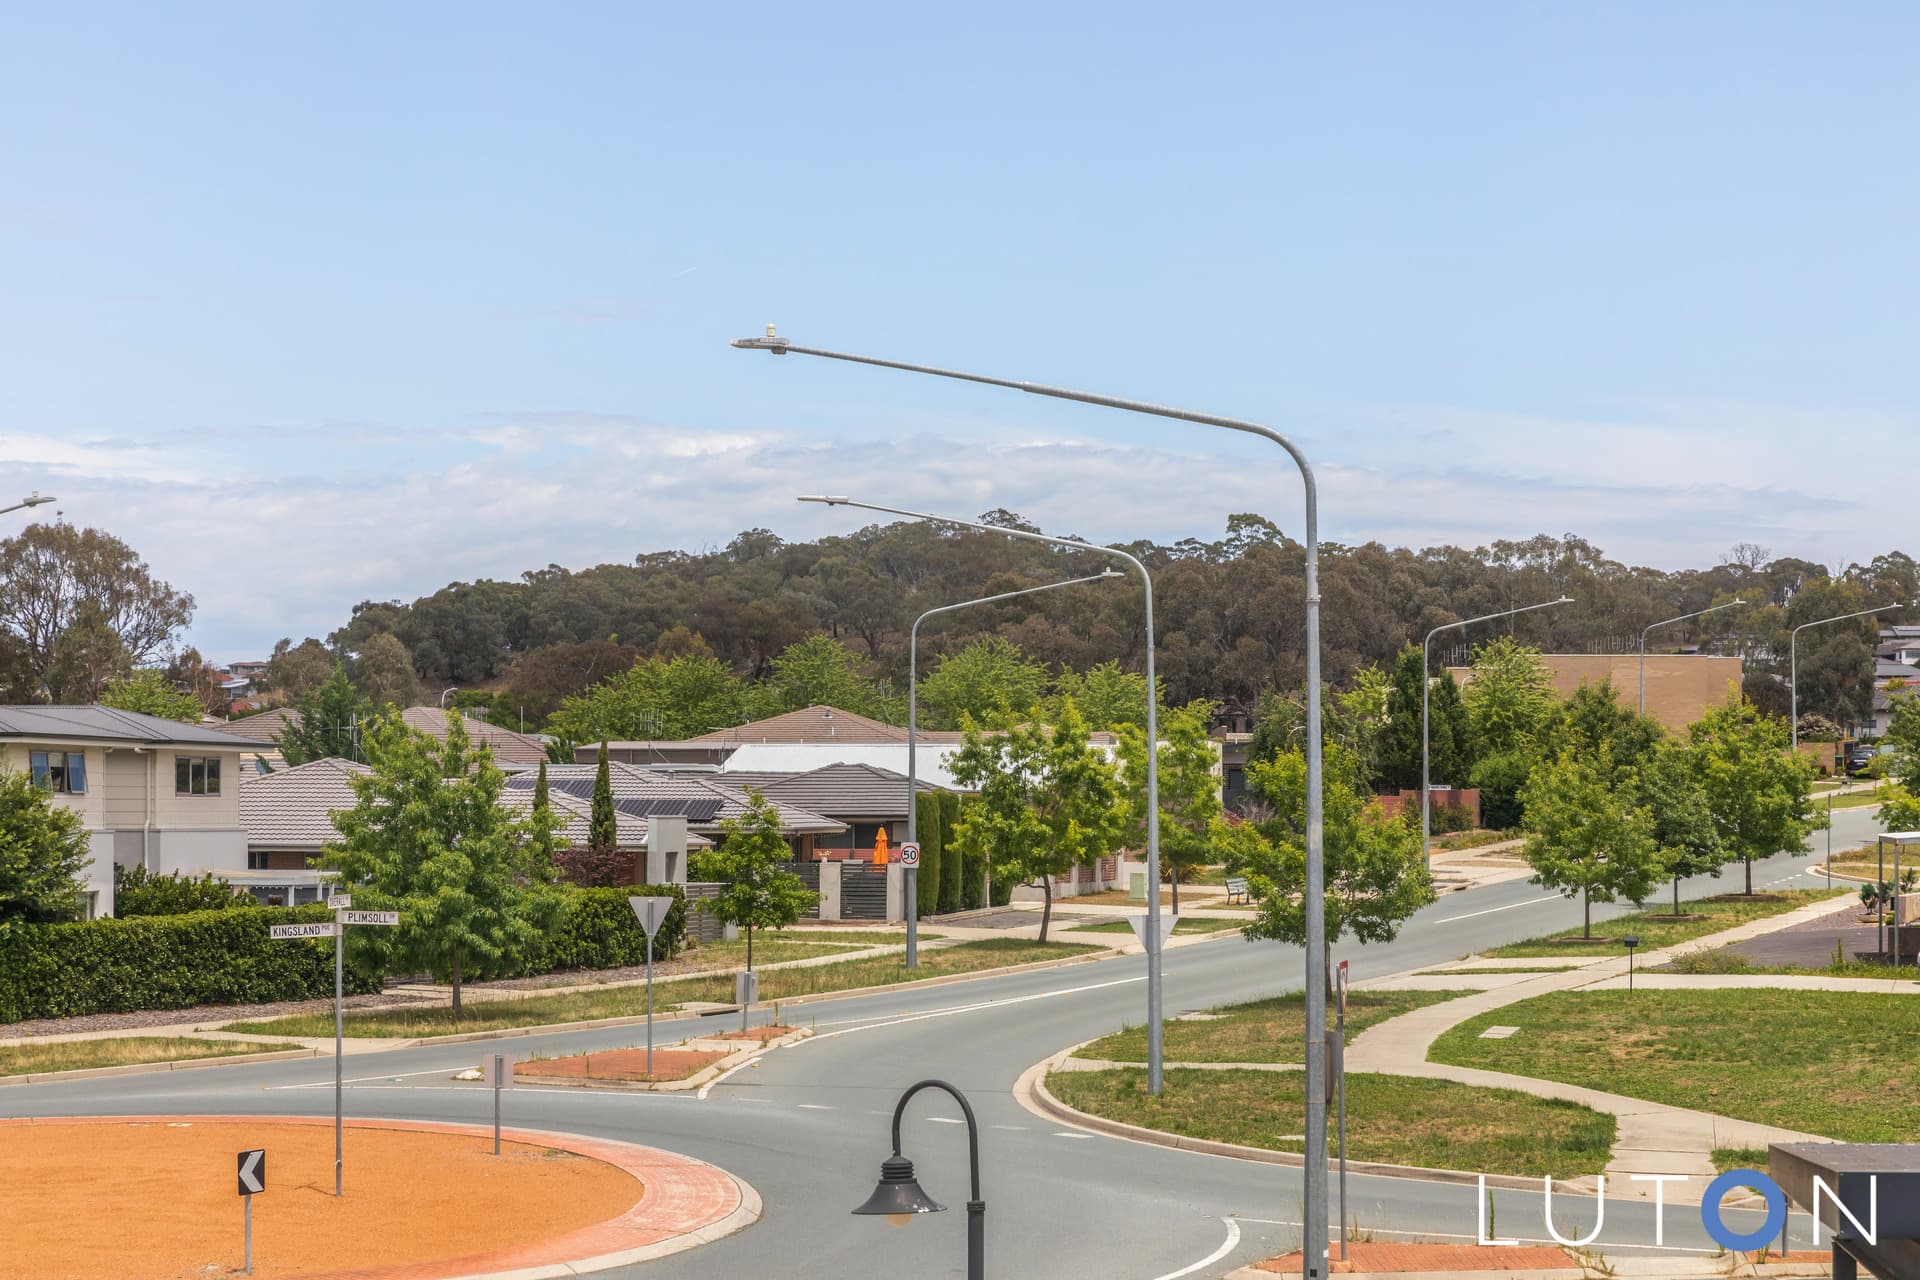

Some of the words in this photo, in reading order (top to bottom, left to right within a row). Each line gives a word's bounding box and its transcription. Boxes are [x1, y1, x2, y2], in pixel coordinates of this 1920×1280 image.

[903, 850, 917, 860] 50
[348, 912, 389, 923] PLIMSOLL
[273, 925, 320, 937] KINGSLAND
